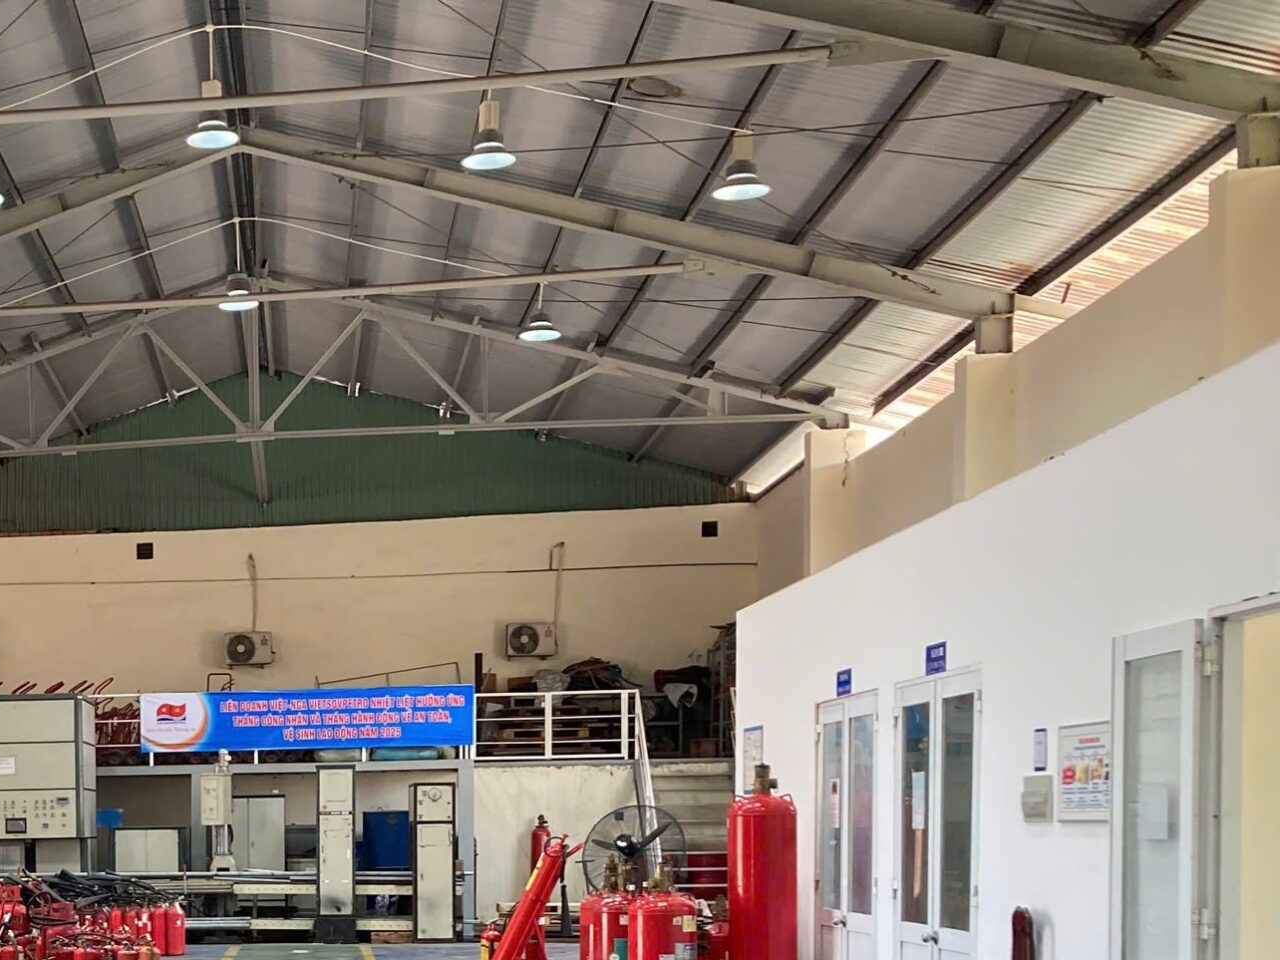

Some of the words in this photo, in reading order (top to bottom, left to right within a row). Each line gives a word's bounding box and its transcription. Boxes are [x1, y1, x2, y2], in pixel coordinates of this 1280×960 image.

[220, 699, 238, 713] LIÊN
[240, 700, 268, 712] DOANH
[308, 698, 369, 710] VIETSOVPETRO
[232, 713, 260, 727] THÁNG
[261, 713, 284, 727] CÔNG
[285, 712, 308, 726] NHÂN
[309, 711, 321, 725] VÀ
[322, 711, 350, 725] THÁNG
[351, 710, 375, 724] HÀNH
[414, 711, 426, 723] AN
[296, 728, 316, 740] SINH
[317, 728, 333, 740] LAO
[359, 725, 378, 738] NĂM
[380, 727, 401, 738] 2025
